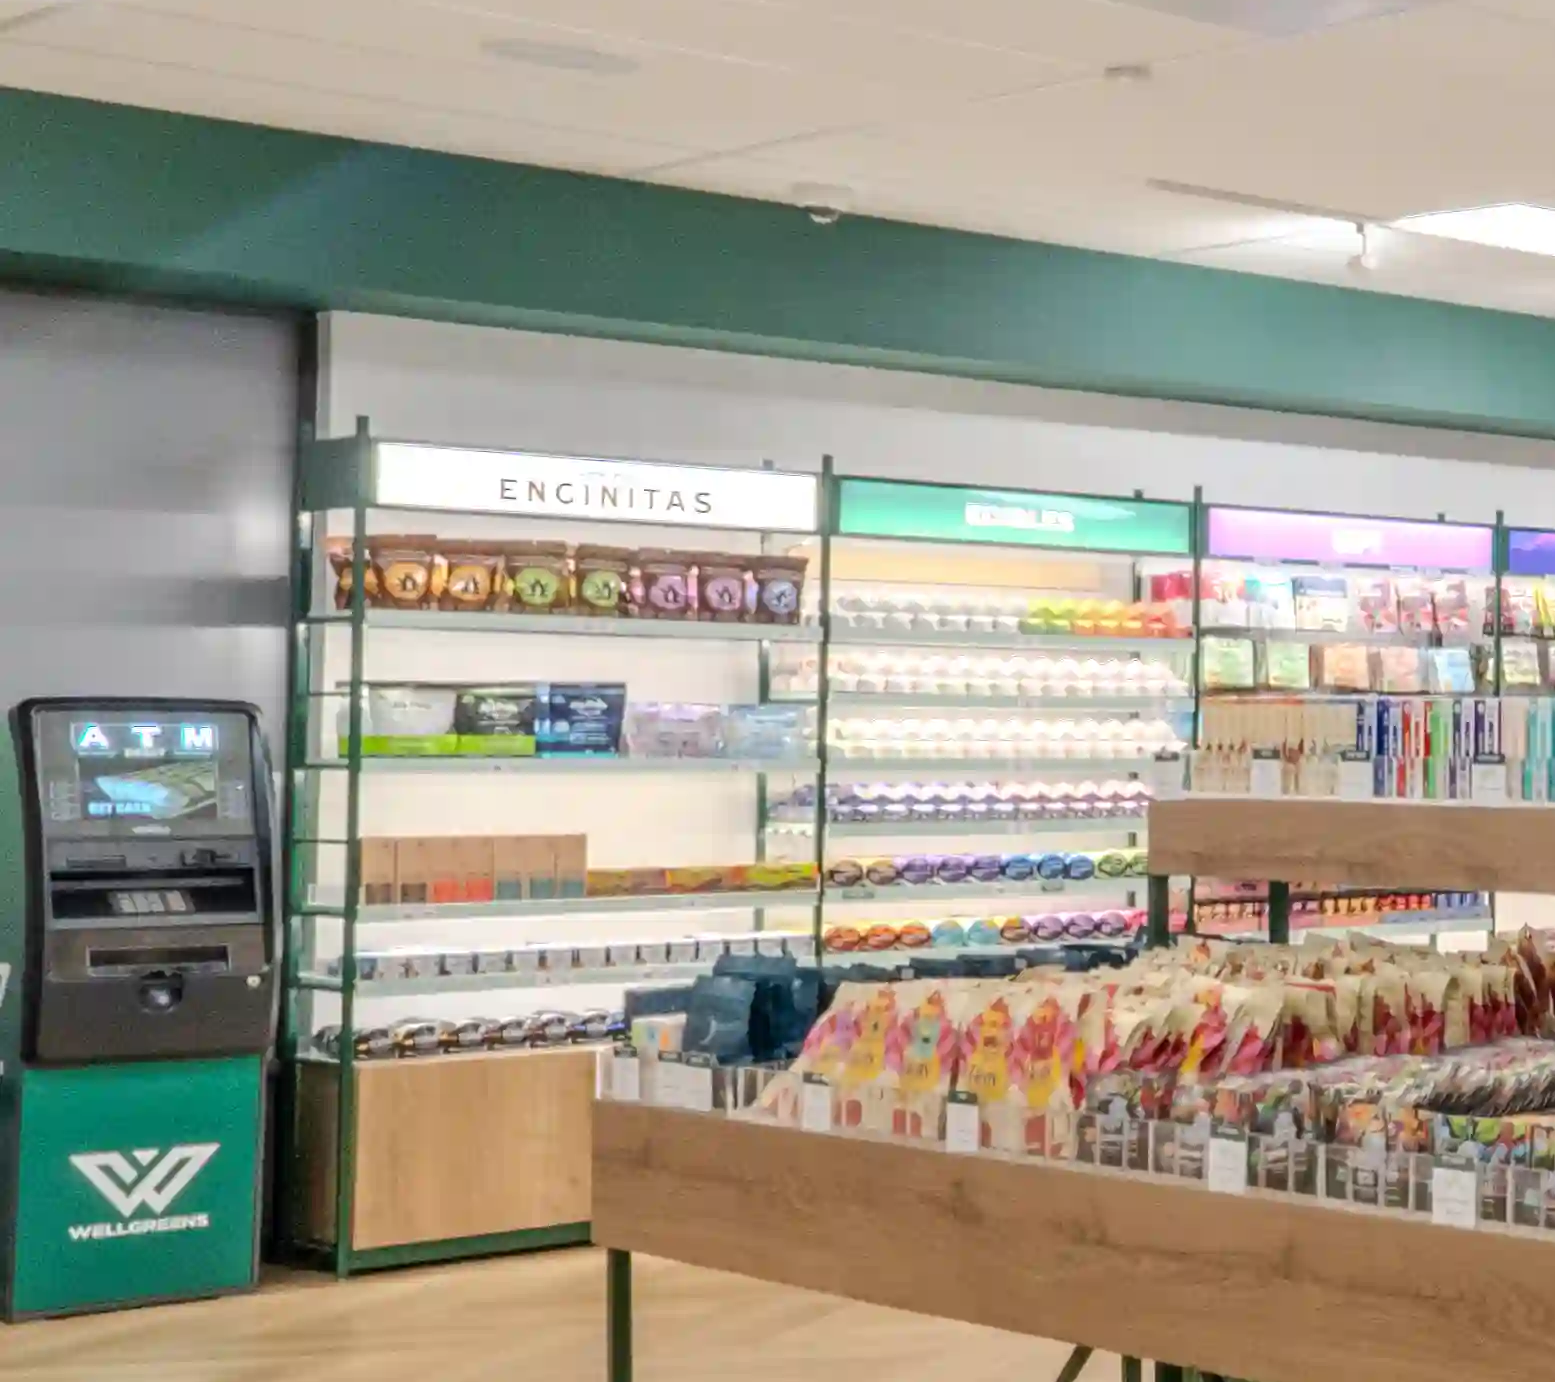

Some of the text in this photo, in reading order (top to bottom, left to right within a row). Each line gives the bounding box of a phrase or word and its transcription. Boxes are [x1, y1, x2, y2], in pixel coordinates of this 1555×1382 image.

[499, 477, 713, 514] ENCINITAS
[78, 724, 214, 749] ATM
[67, 1212, 211, 1240] WELLGREENS
